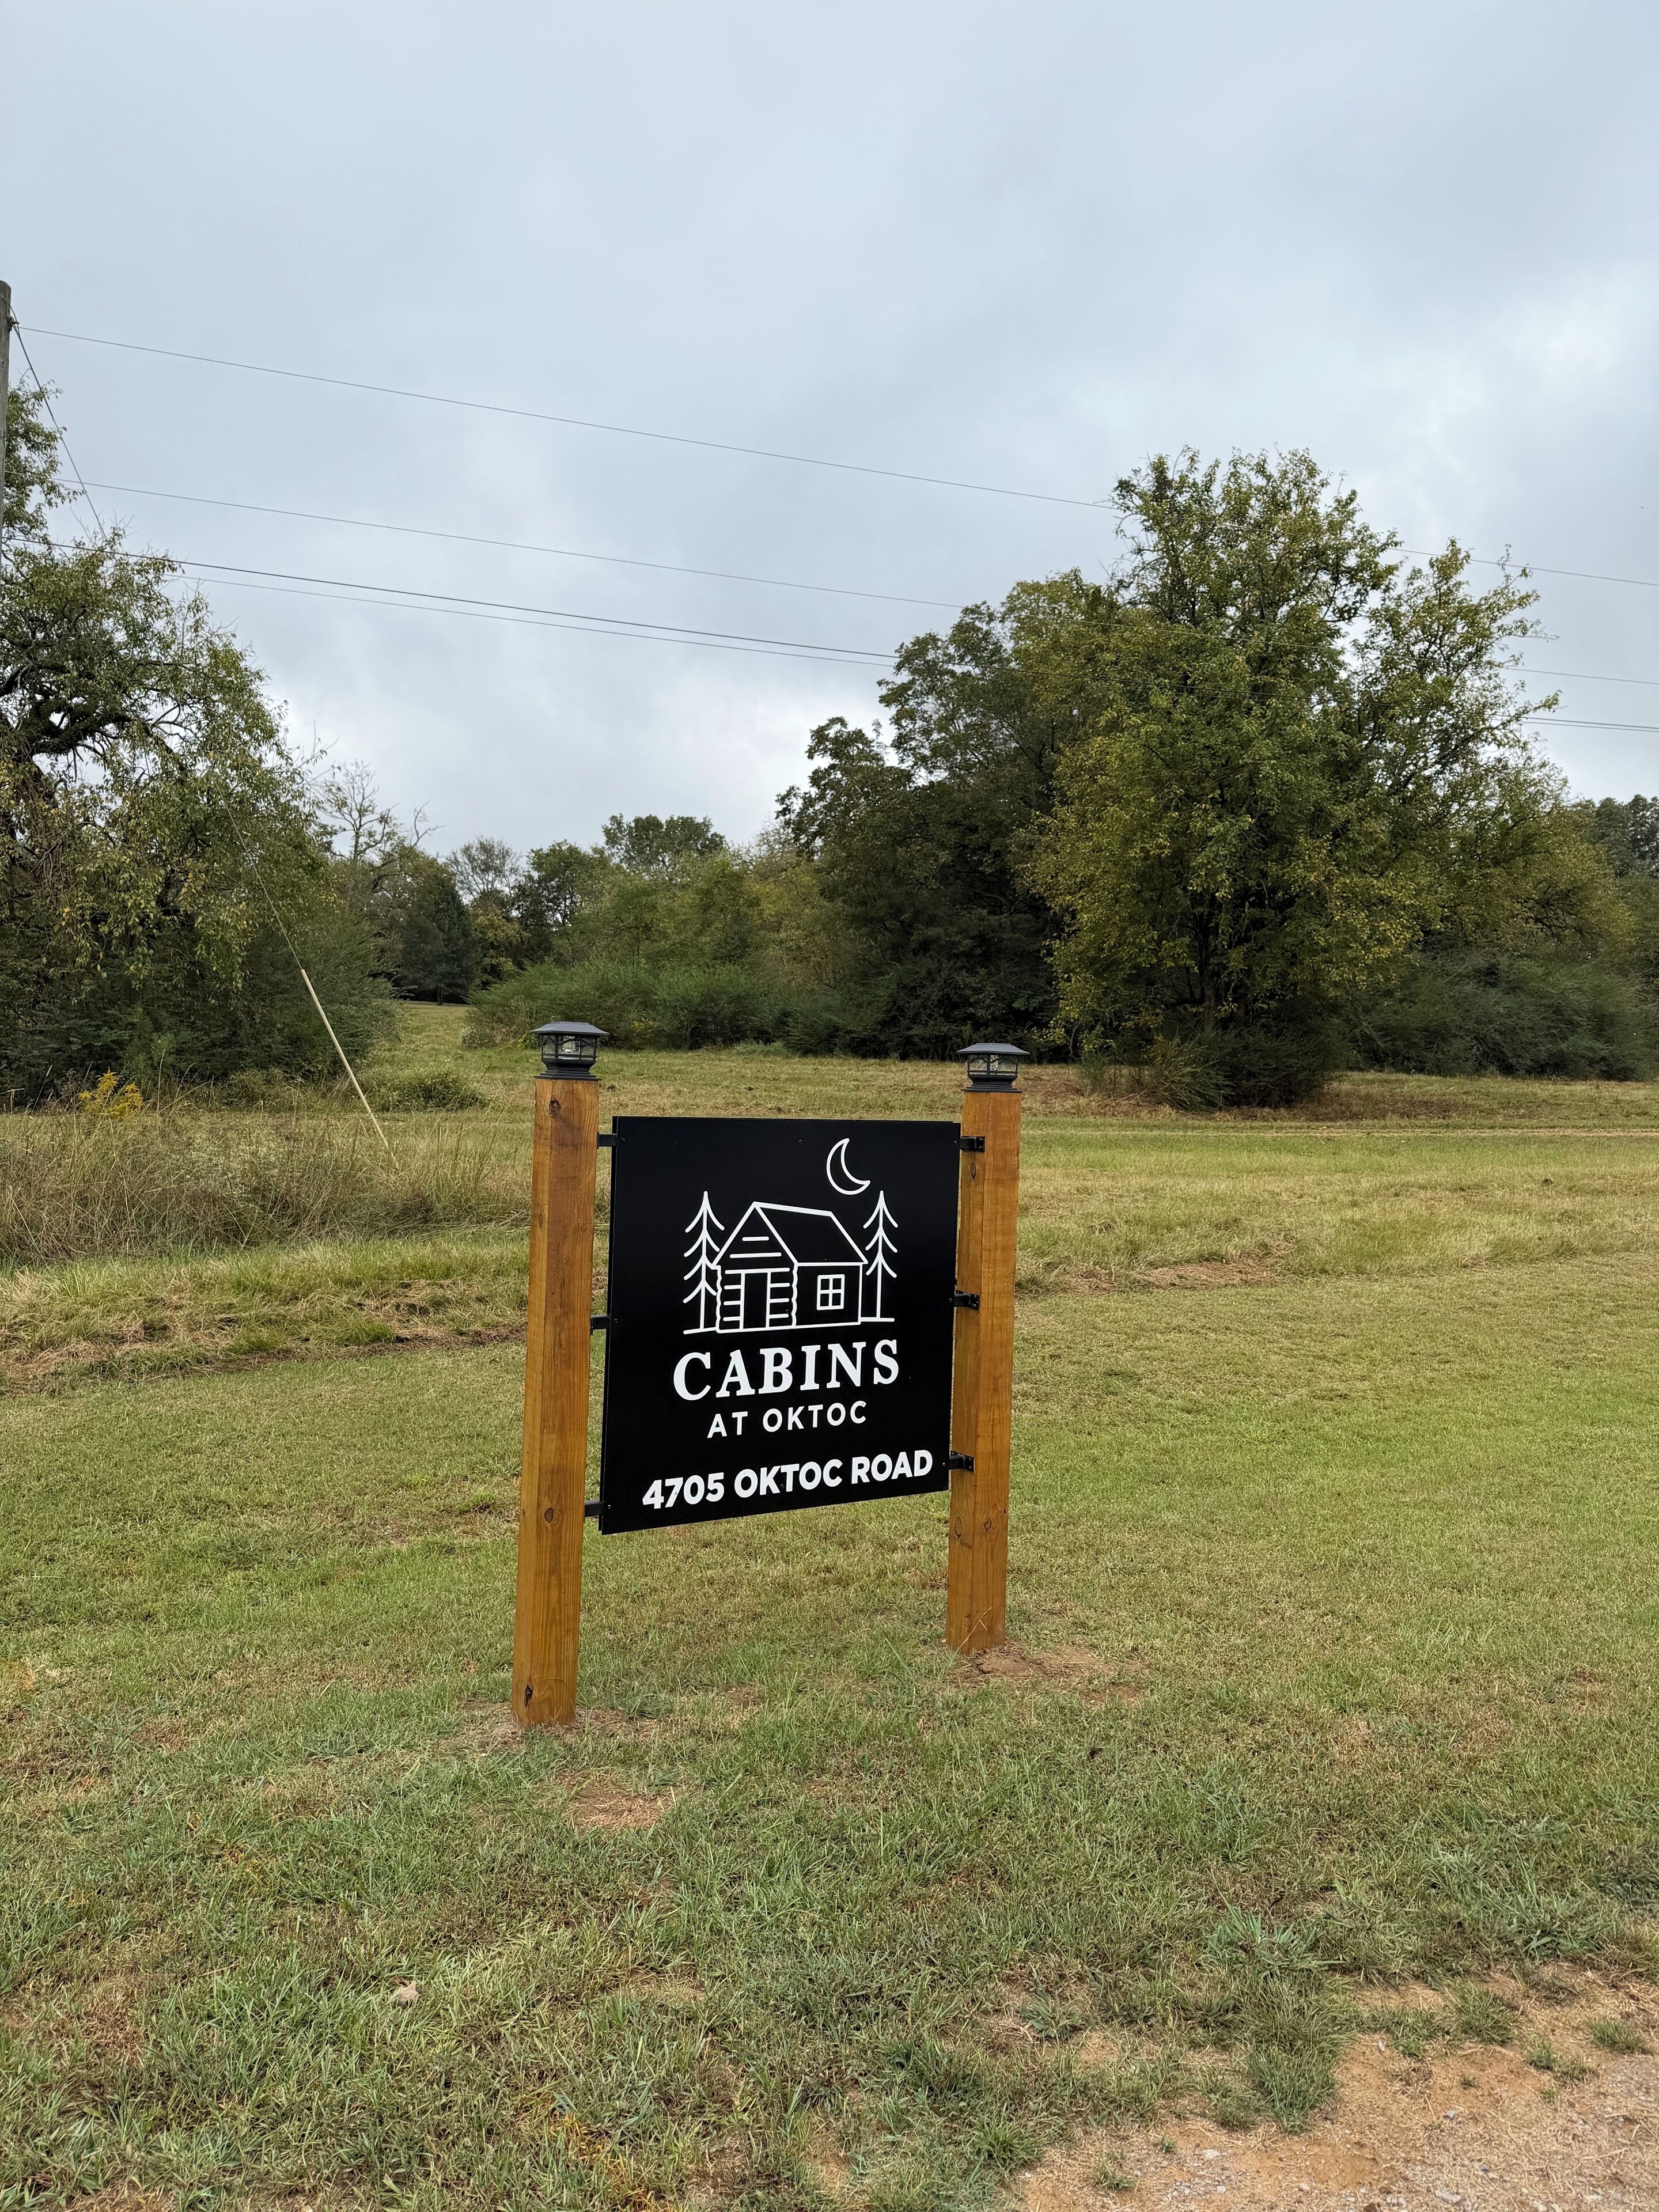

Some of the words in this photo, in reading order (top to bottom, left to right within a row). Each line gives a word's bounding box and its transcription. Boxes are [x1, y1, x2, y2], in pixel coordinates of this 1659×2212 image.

[673, 1339, 900, 1401] CABINS
[707, 1411, 748, 1438] AT
[762, 1400, 867, 1433] OKTOC
[642, 1472, 725, 1509] 4705
[734, 1459, 843, 1498] OKTOC
[851, 1449, 933, 1484] ROAD
